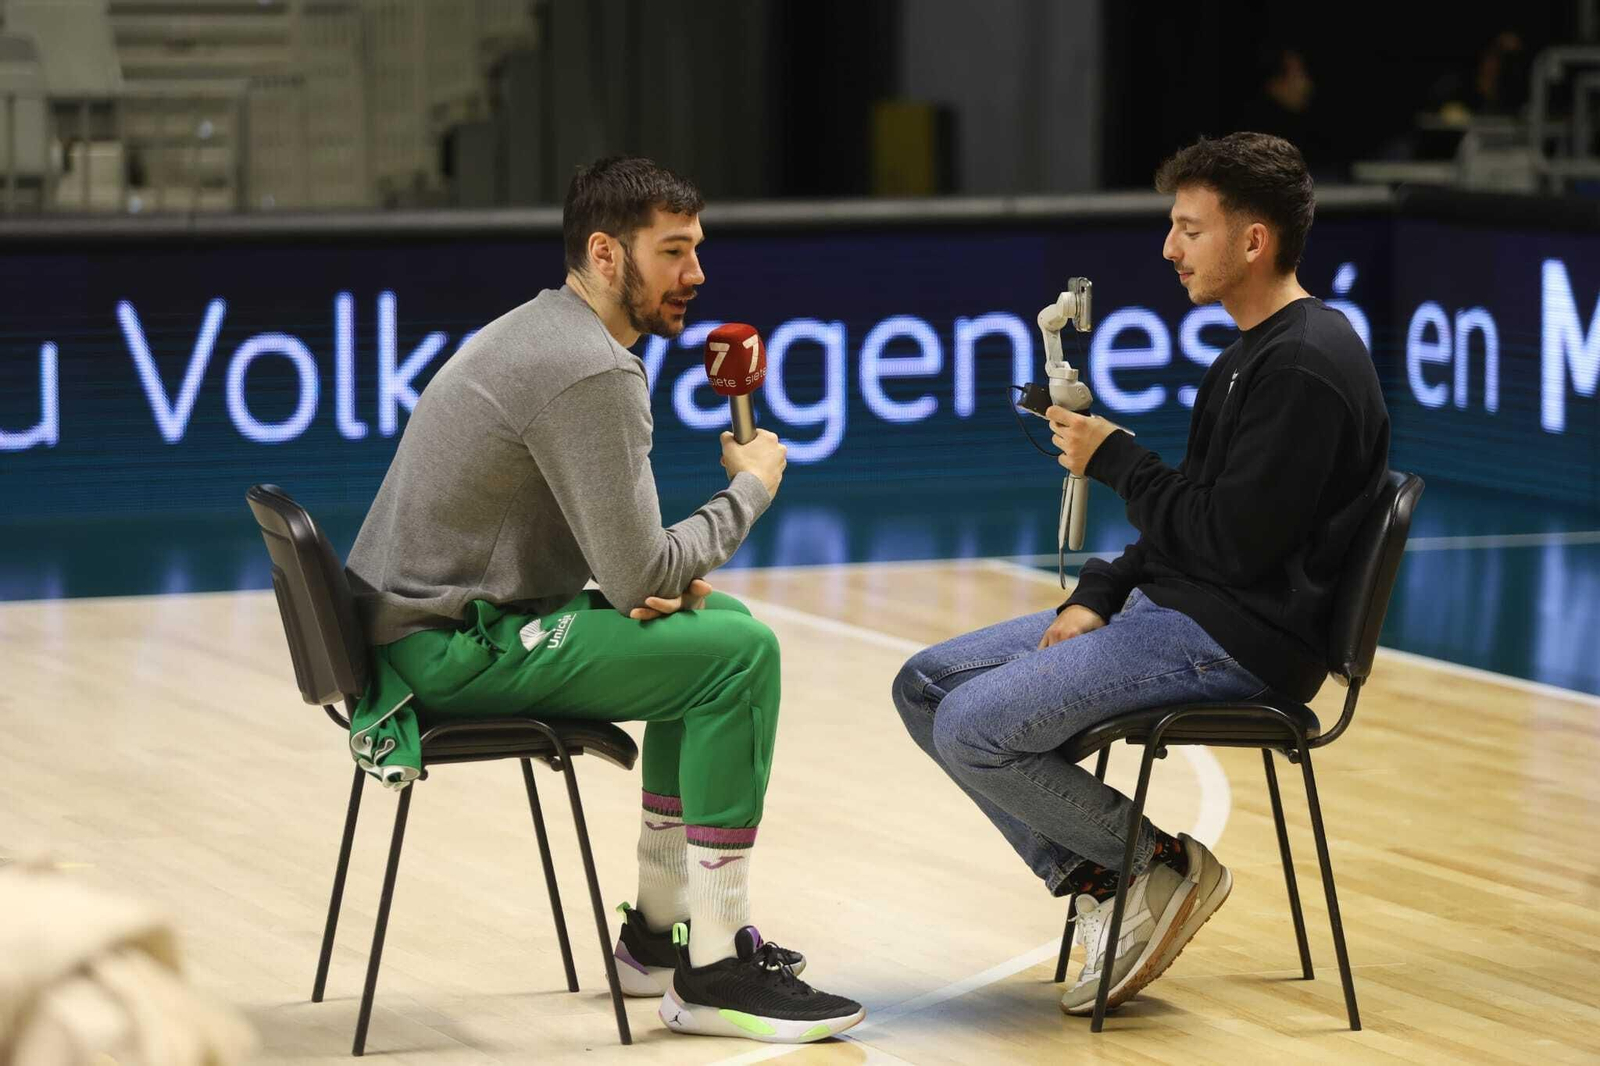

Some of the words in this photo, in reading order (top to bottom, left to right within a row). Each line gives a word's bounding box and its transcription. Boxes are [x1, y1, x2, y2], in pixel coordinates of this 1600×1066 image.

[708, 341, 731, 376] 7
[743, 333, 759, 374] 7
[1407, 301, 1498, 412] en
